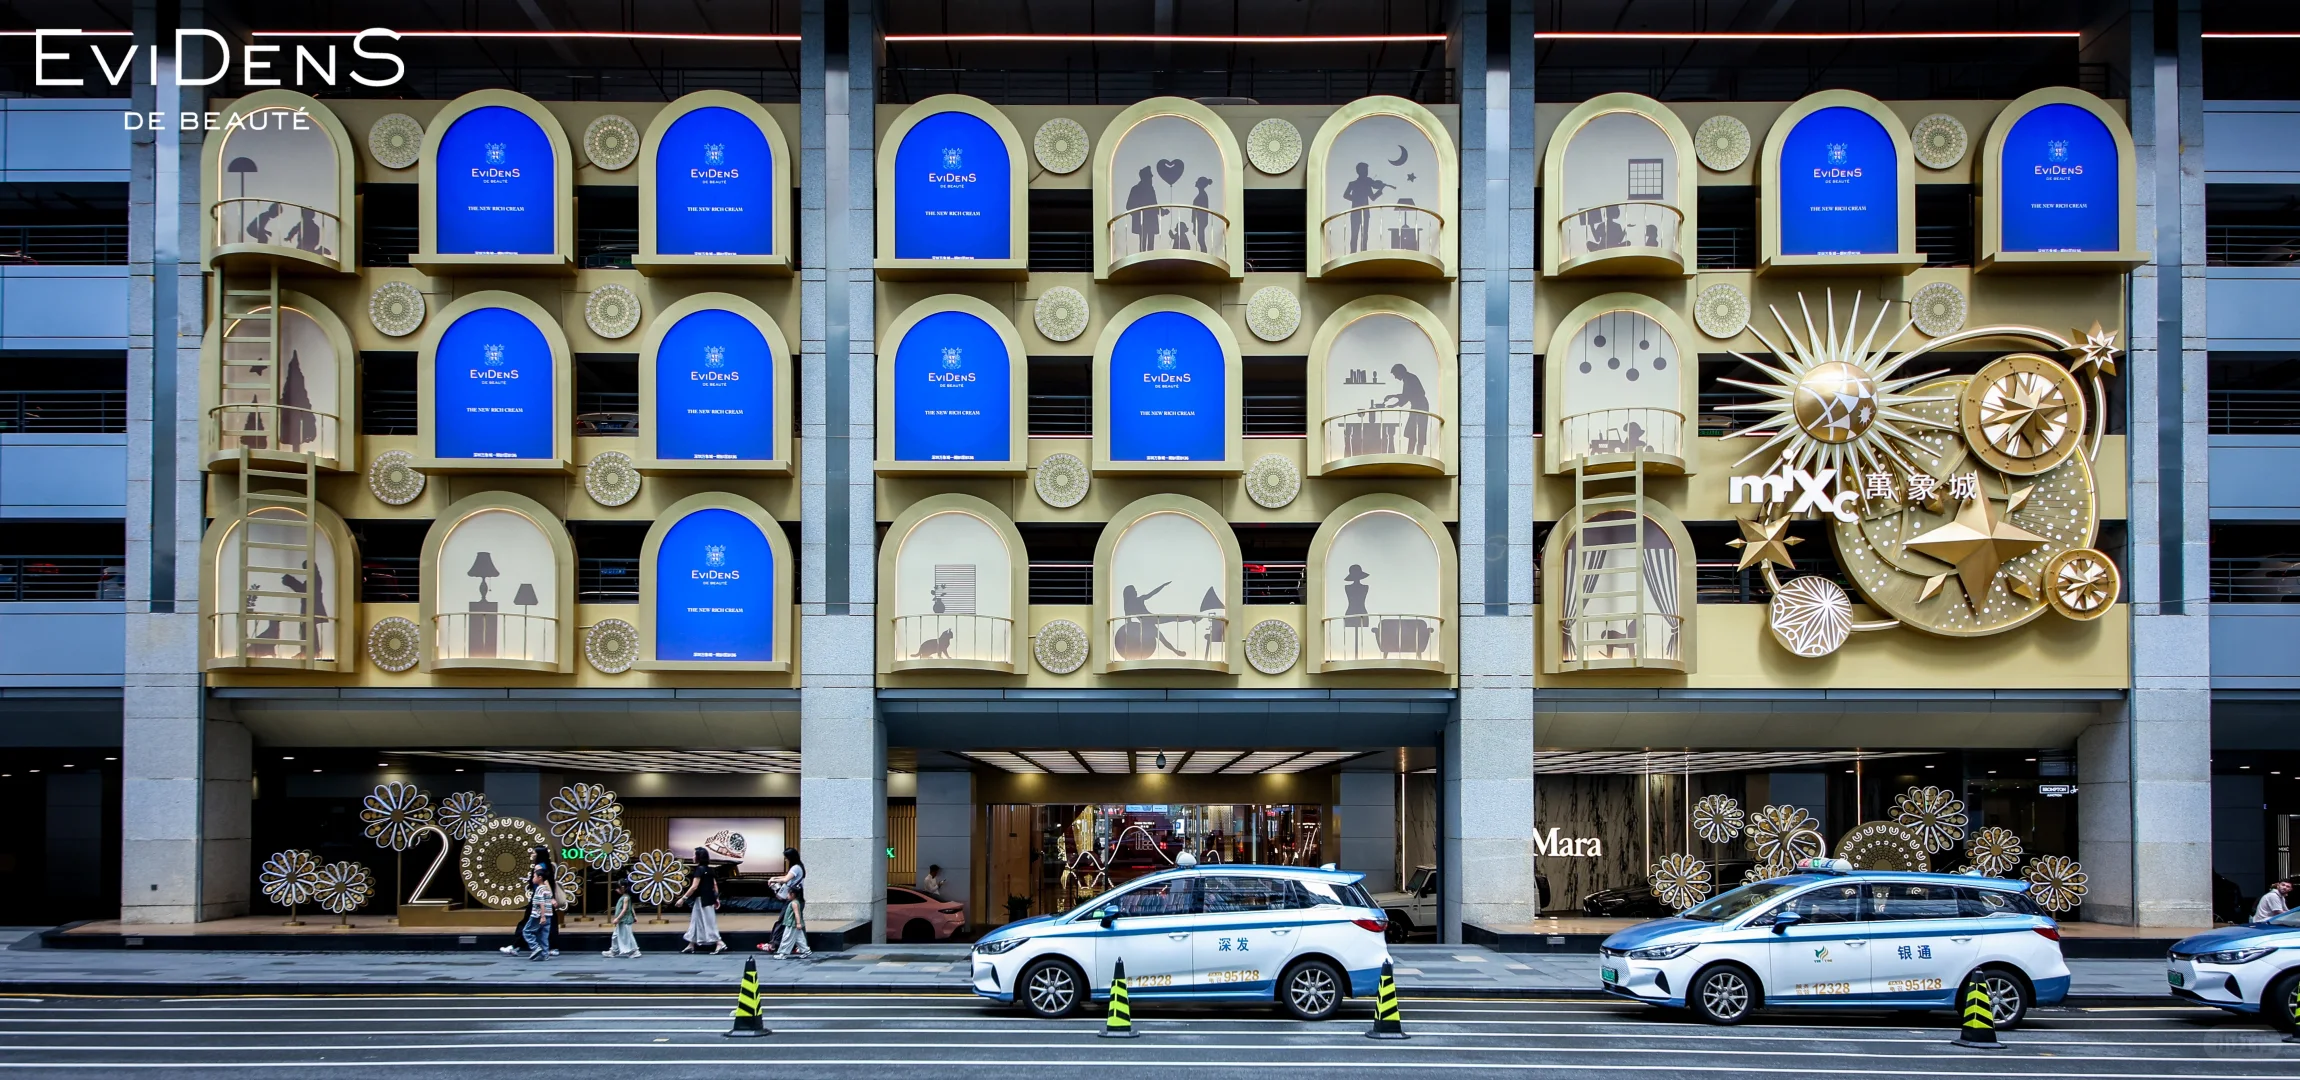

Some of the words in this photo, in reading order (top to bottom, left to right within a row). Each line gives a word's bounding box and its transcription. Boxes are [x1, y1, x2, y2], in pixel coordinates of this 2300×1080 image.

[1865, 472, 1977, 500] 萬象城
[1532, 827, 1602, 857] Mara
[1218, 937, 1249, 952] 深发
[1898, 945, 1932, 960] 银通
[1135, 974, 1172, 987] 12328
[1224, 969, 1260, 982] 95128
[1812, 982, 1850, 995] 12328
[1905, 978, 1942, 991] 95128
